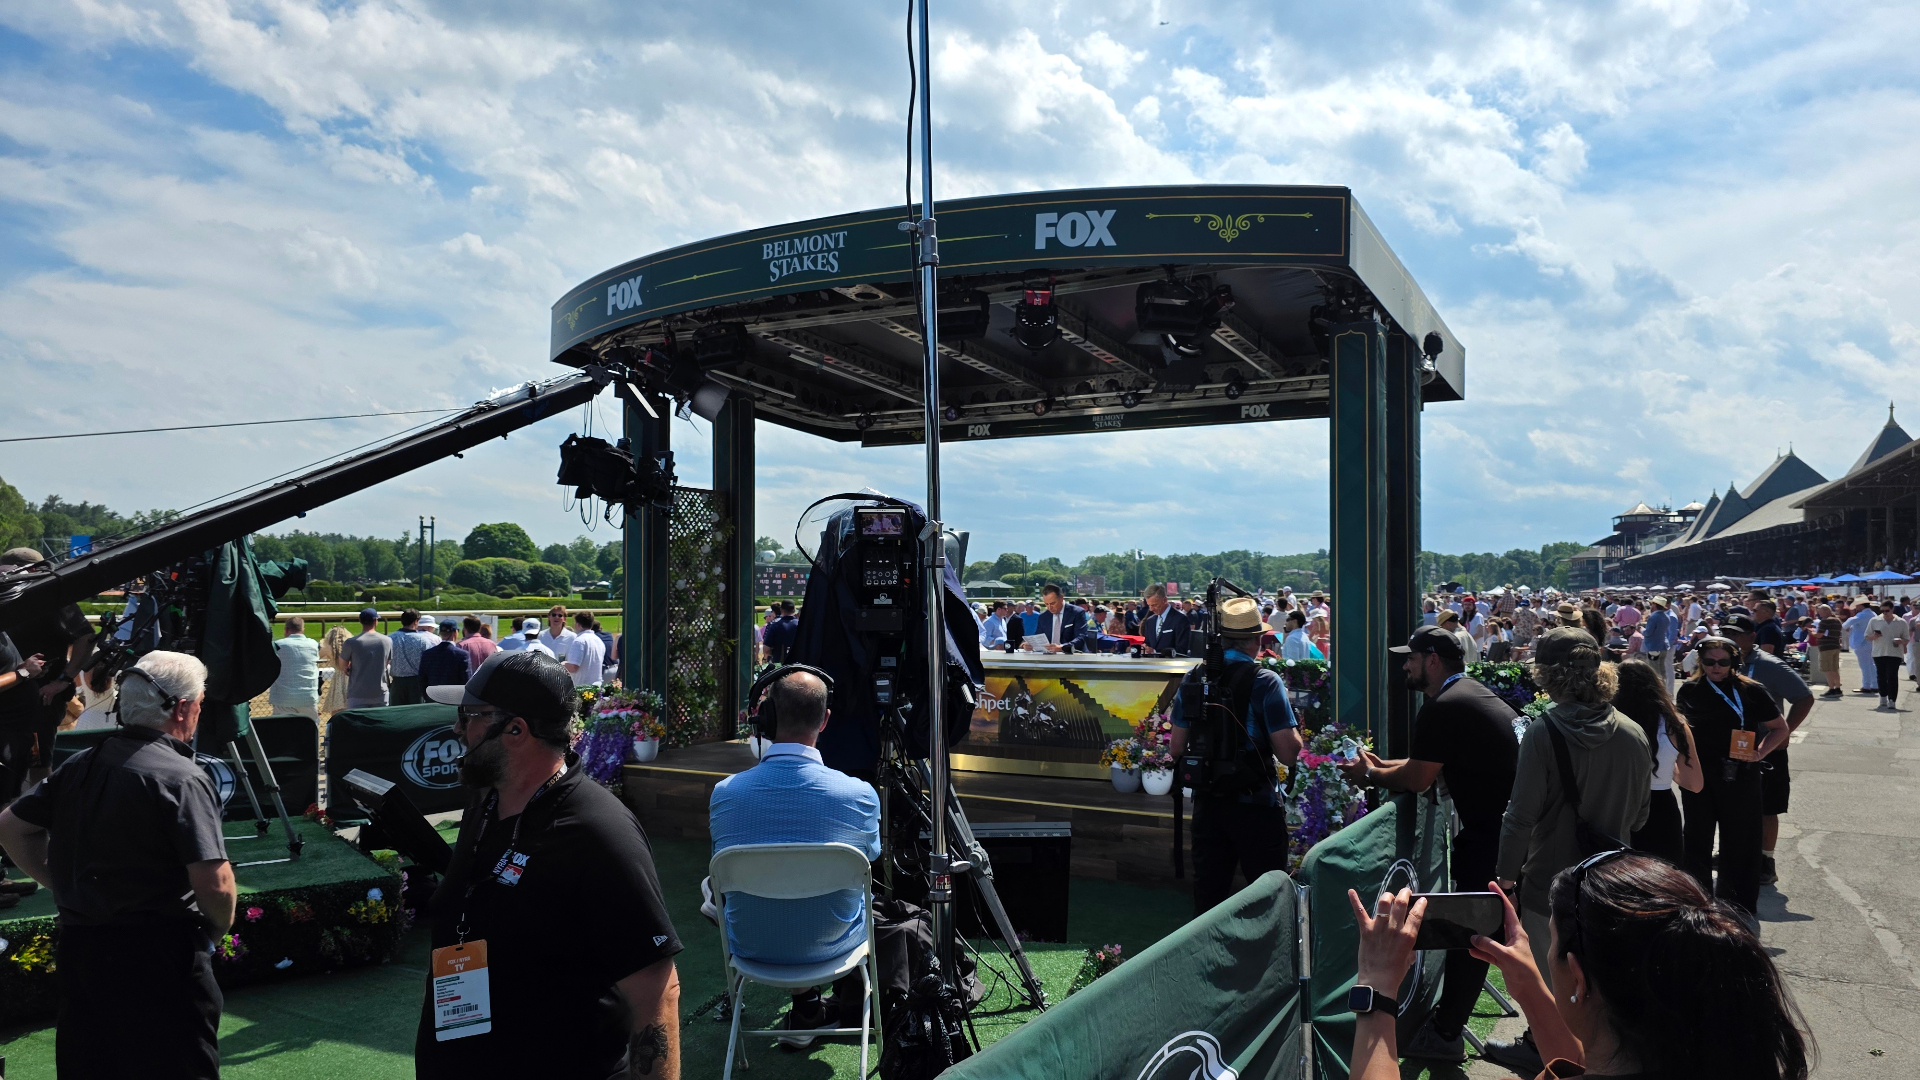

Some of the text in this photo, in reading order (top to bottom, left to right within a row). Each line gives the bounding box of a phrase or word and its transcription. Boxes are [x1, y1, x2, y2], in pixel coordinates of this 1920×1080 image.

[1035, 210, 1117, 250] FOX
[762, 231, 848, 260] BELMONT
[769, 251, 839, 282] STAKES
[607, 275, 643, 316] FOX
[1092, 414, 1124, 422] BELMONT
[1241, 404, 1270, 419] FOX
[967, 424, 990, 438] FOX
[1094, 420, 1121, 430] STAKES
[974, 694, 1011, 713] shpet
[1737, 740, 1749, 748] TV
[422, 763, 459, 778] SPOR
[512, 851, 530, 867] OX
[455, 963, 464, 971] TV
